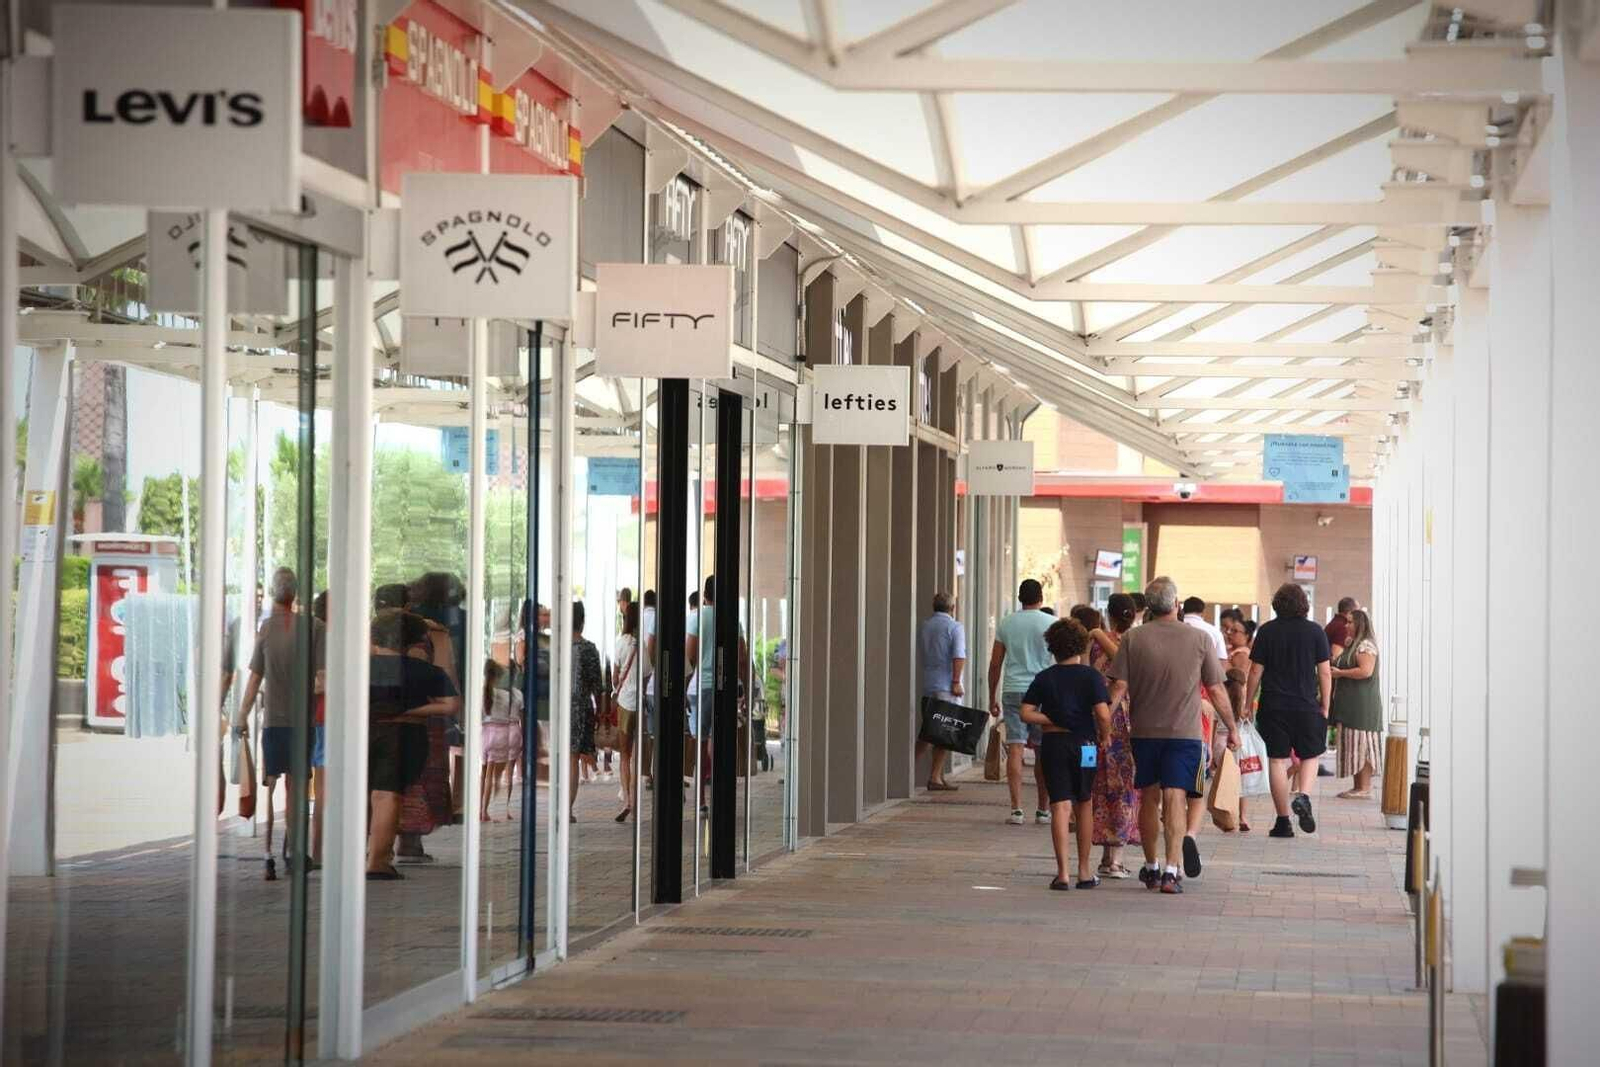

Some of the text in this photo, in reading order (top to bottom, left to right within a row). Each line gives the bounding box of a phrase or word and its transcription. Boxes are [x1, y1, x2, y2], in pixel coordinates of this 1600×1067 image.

[421, 209, 553, 248] SPAGNOLO
[612, 312, 714, 329] FIFTY
[824, 392, 898, 412] lefties
[932, 712, 973, 729] FIFTY
